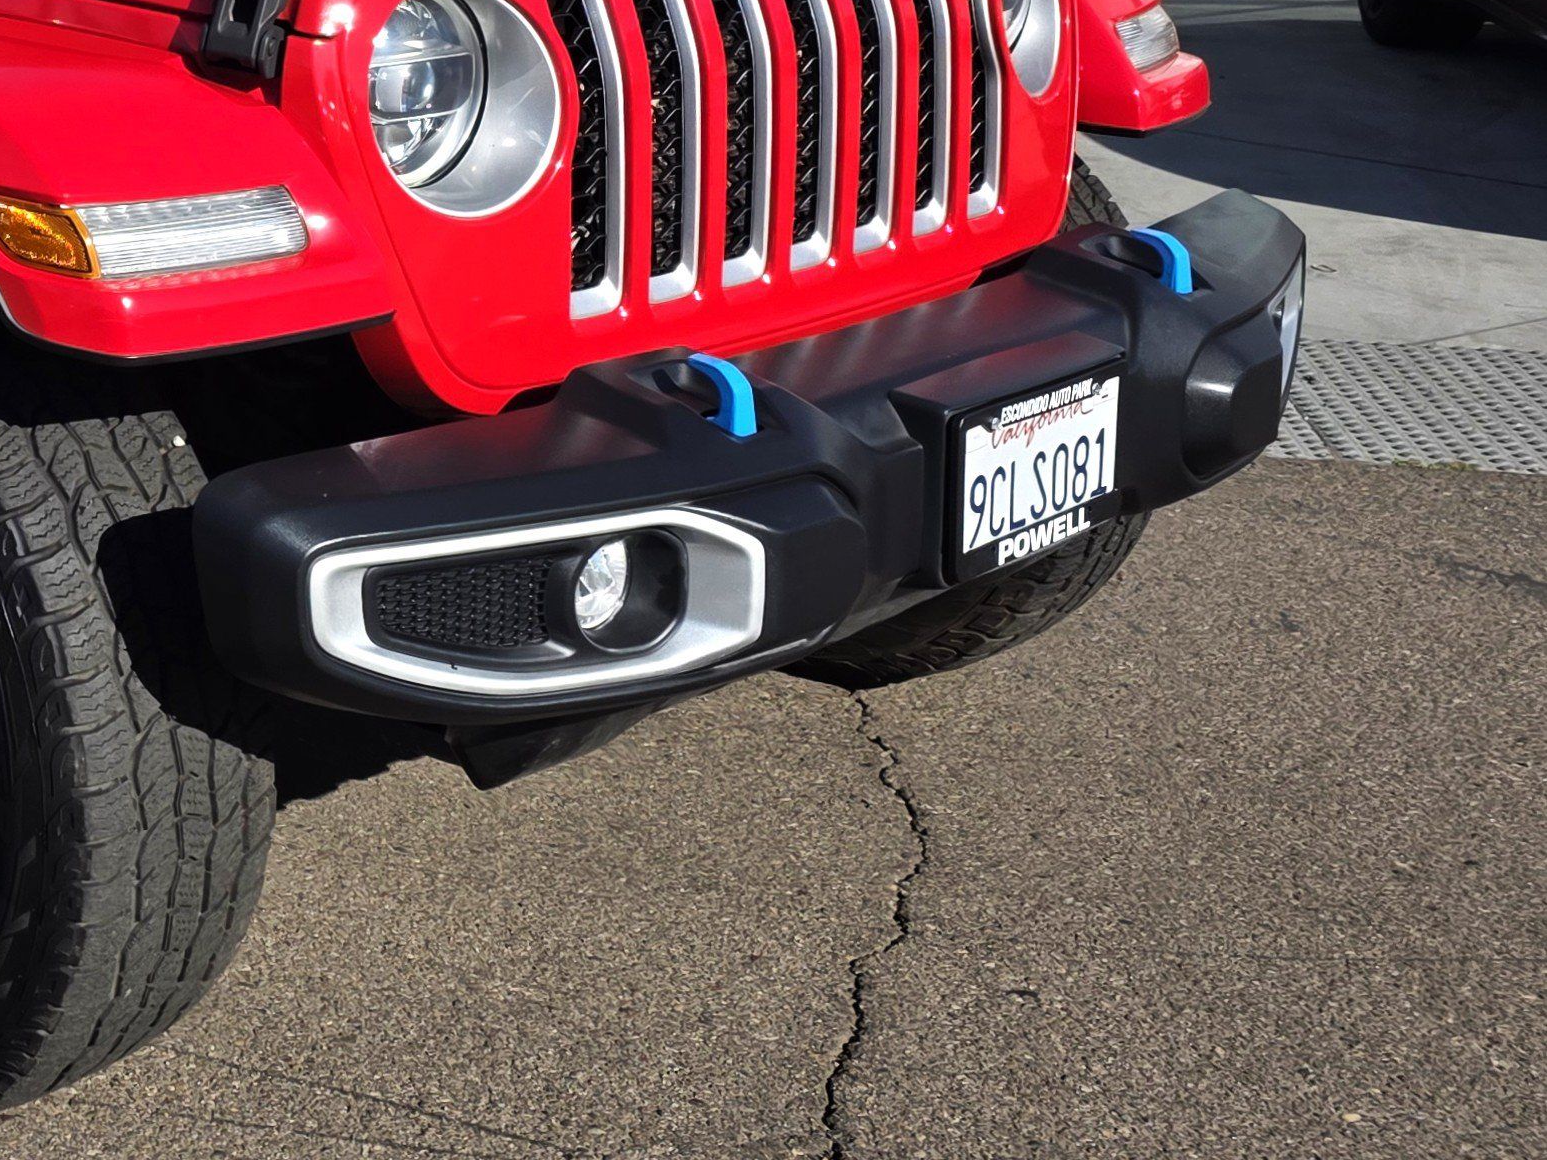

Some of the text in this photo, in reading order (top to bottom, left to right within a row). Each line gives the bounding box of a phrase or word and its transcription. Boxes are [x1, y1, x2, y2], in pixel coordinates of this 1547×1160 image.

[1000, 378, 1093, 424] ESCONDIDO AUTO PARK
[969, 428, 1107, 548] 9CLS081
[998, 507, 1091, 566] POWELL
